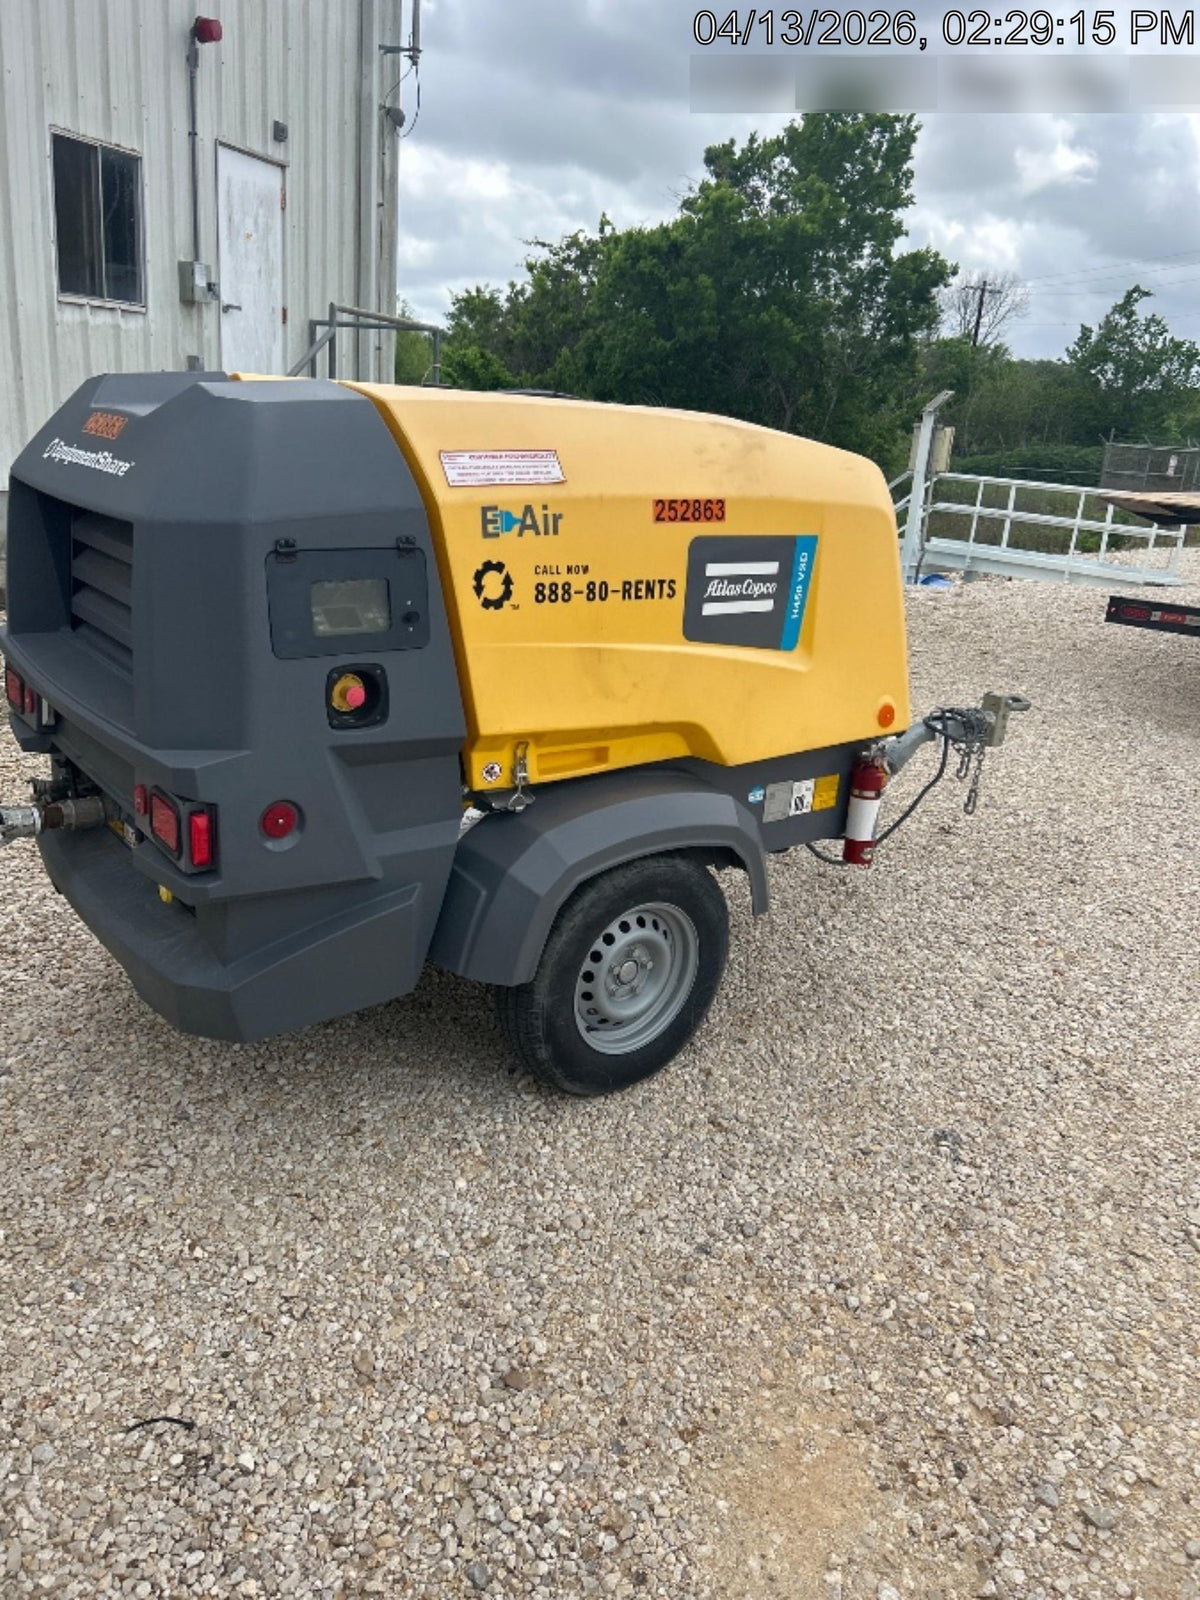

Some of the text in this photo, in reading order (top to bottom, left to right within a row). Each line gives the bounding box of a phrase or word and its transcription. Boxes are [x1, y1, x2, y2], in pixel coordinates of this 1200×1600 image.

[655, 499, 725, 521] 252863
[534, 564, 590, 575] CALL NOW
[798, 552, 808, 582] VSD
[534, 579, 677, 604] 888-80-RENTS
[703, 578, 778, 599] Atlas Copco
